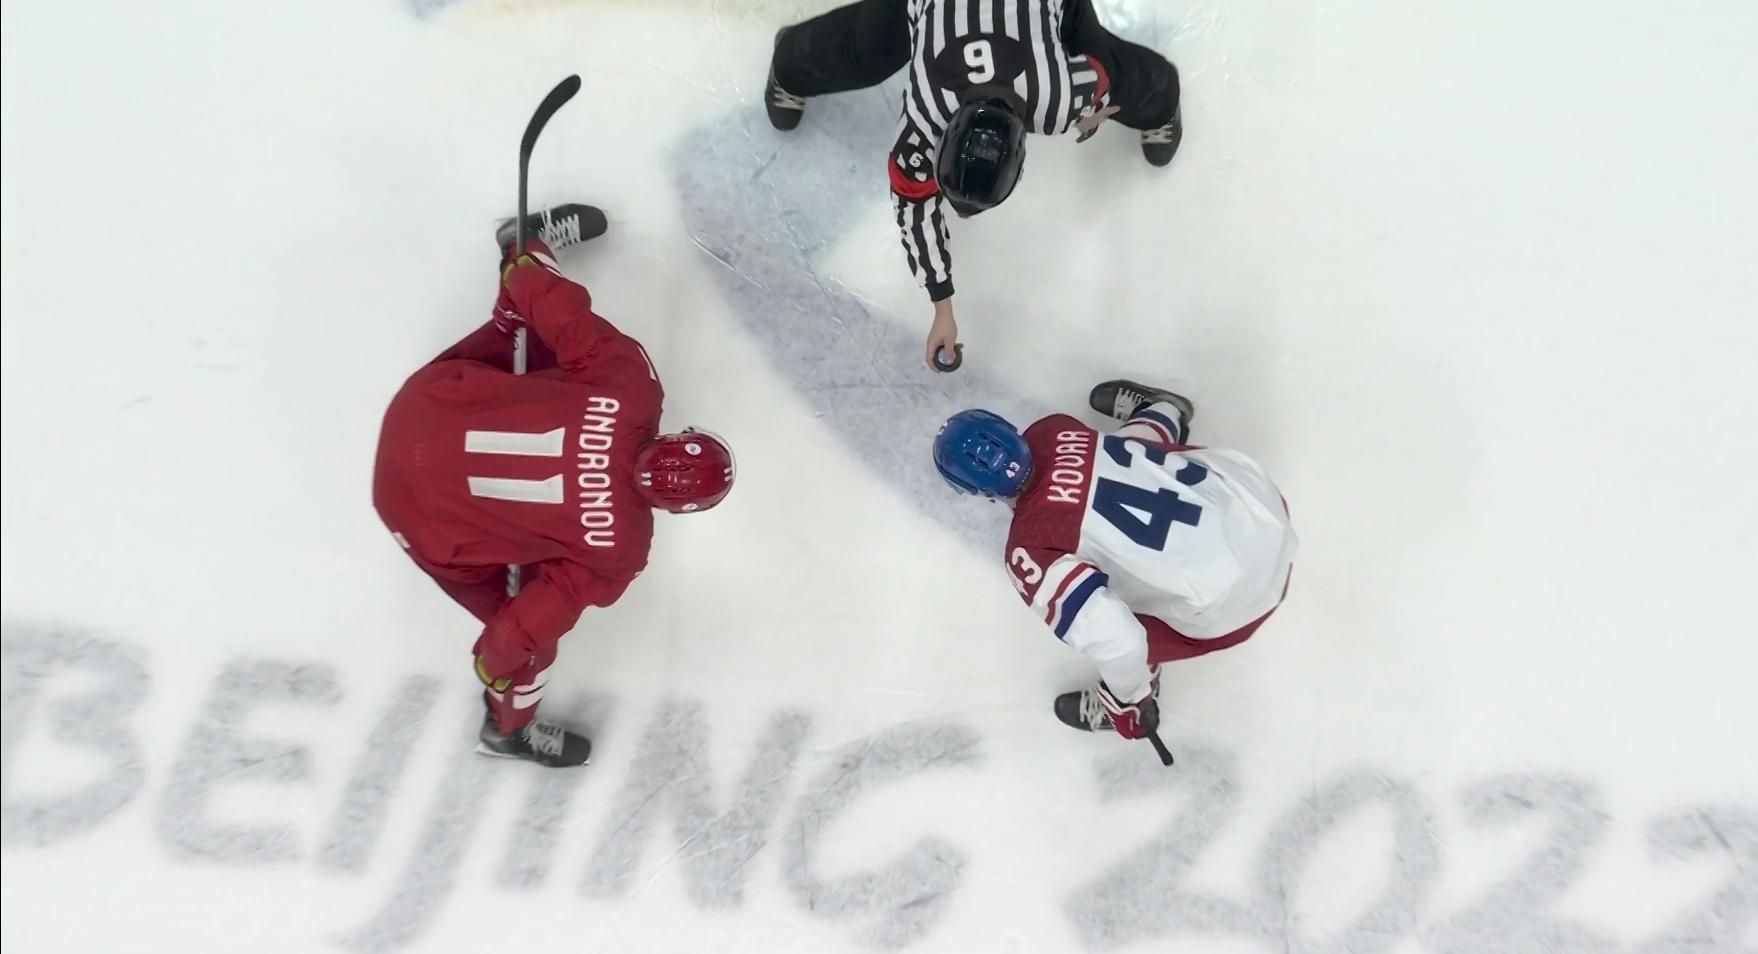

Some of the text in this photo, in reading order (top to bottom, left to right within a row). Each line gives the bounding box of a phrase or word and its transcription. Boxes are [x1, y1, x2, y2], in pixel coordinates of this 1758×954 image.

[908, 151, 925, 168] 6
[464, 427, 566, 504] 11
[577, 396, 620, 548] ANDRONOV
[1005, 461, 1021, 478] 43
[1047, 429, 1090, 505] KOVAR
[1092, 434, 1208, 552] 43
[0, 620, 983, 953] BEIJING
